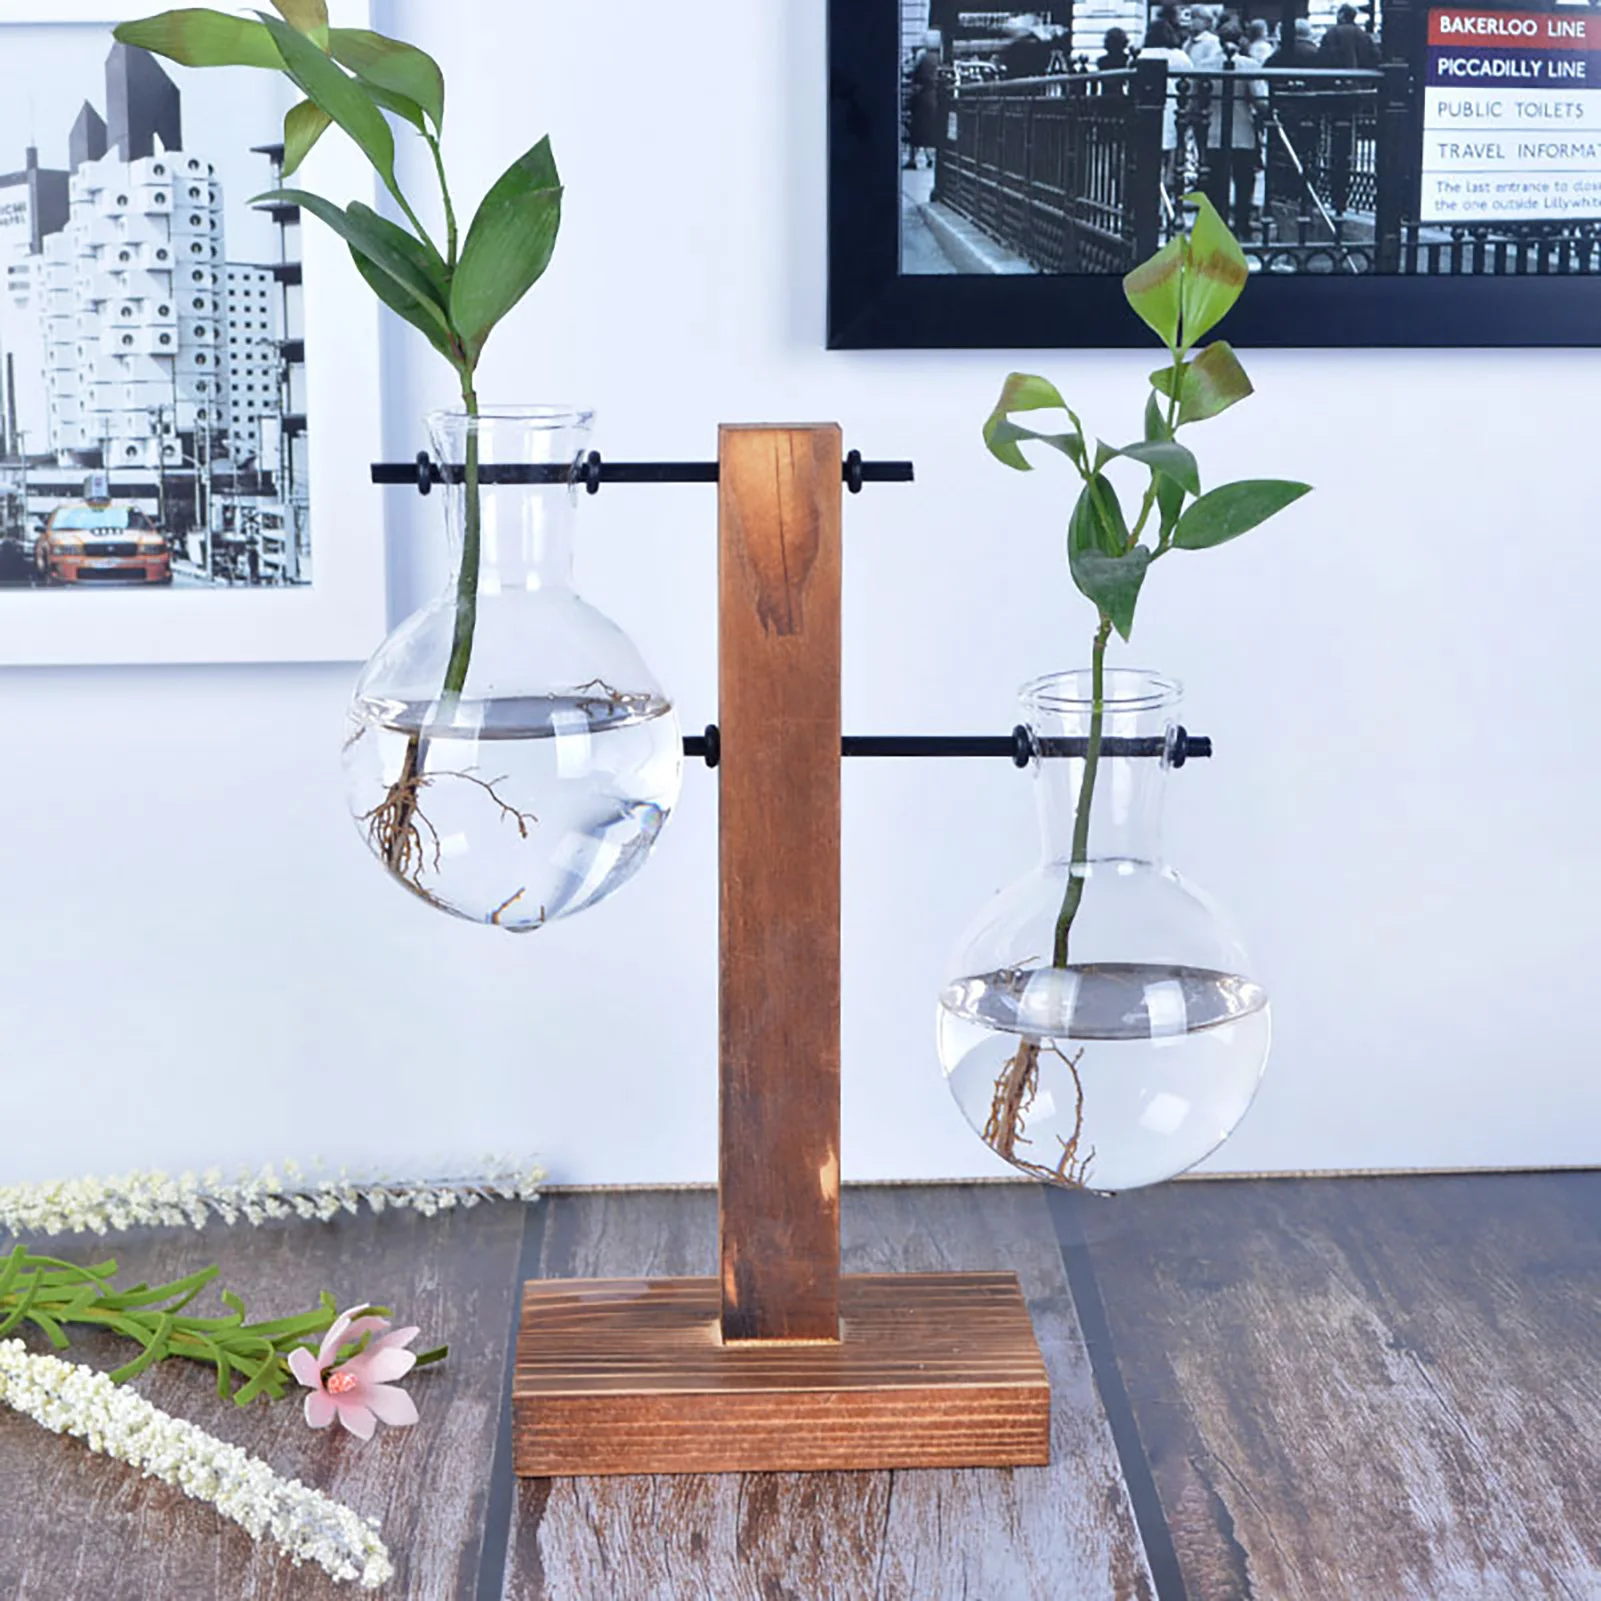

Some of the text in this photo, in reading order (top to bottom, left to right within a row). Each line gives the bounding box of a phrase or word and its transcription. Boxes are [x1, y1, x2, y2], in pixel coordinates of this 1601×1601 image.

[1440, 15, 1586, 38] BAKERLOO LINE
[1437, 57, 1586, 78] PICCADILLY LINE
[1438, 101, 1584, 119] PUBLIC TOILETS
[1438, 143, 1601, 159] TRAVEL INFORMA
[1437, 180, 1461, 193] The
[1554, 181, 1569, 193] to
[1435, 199, 1457, 211] the
[1462, 200, 1487, 211] one
